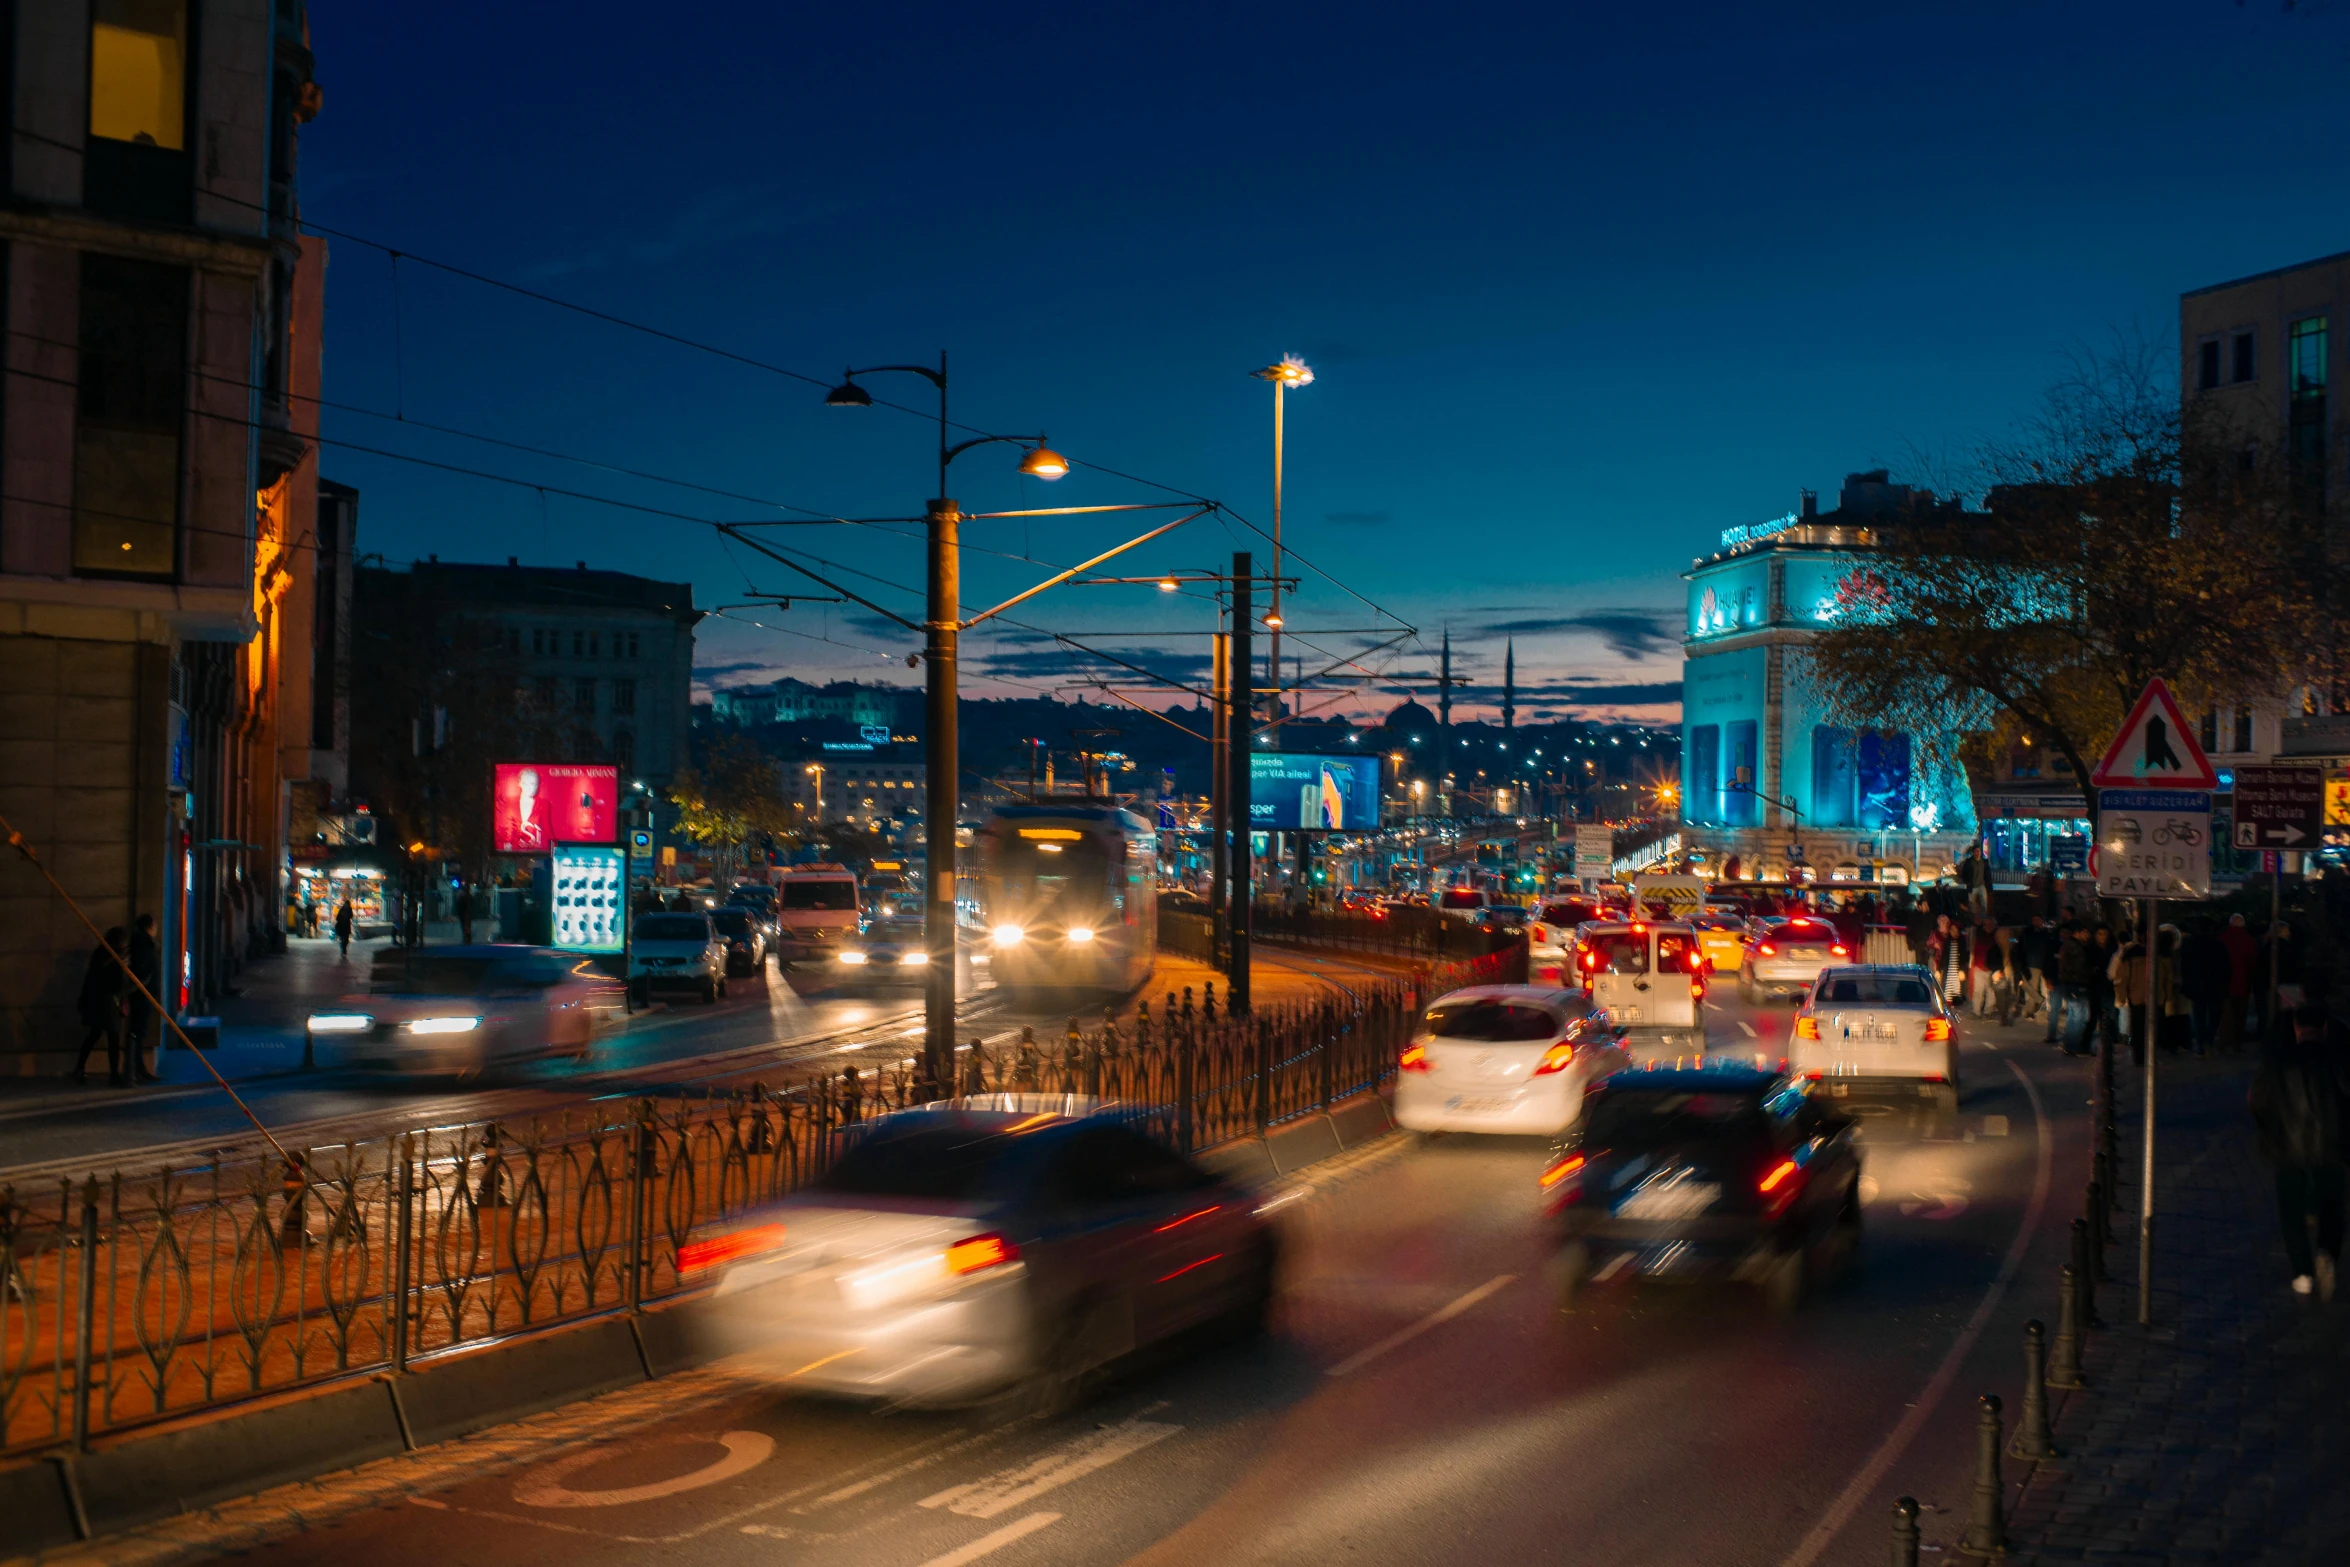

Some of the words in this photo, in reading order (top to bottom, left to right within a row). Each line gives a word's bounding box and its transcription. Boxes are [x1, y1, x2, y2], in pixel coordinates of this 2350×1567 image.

[1721, 524, 1749, 547] HOTEL
[1718, 586, 1755, 610] HUAWEI
[549, 767, 583, 778] GIORGIO
[585, 768, 617, 779] ARMANI
[2288, 787, 2319, 802] Museum
[2250, 804, 2274, 818] SALT
[2275, 805, 2305, 819] Galata
[1643, 896, 1665, 904] OKUL
